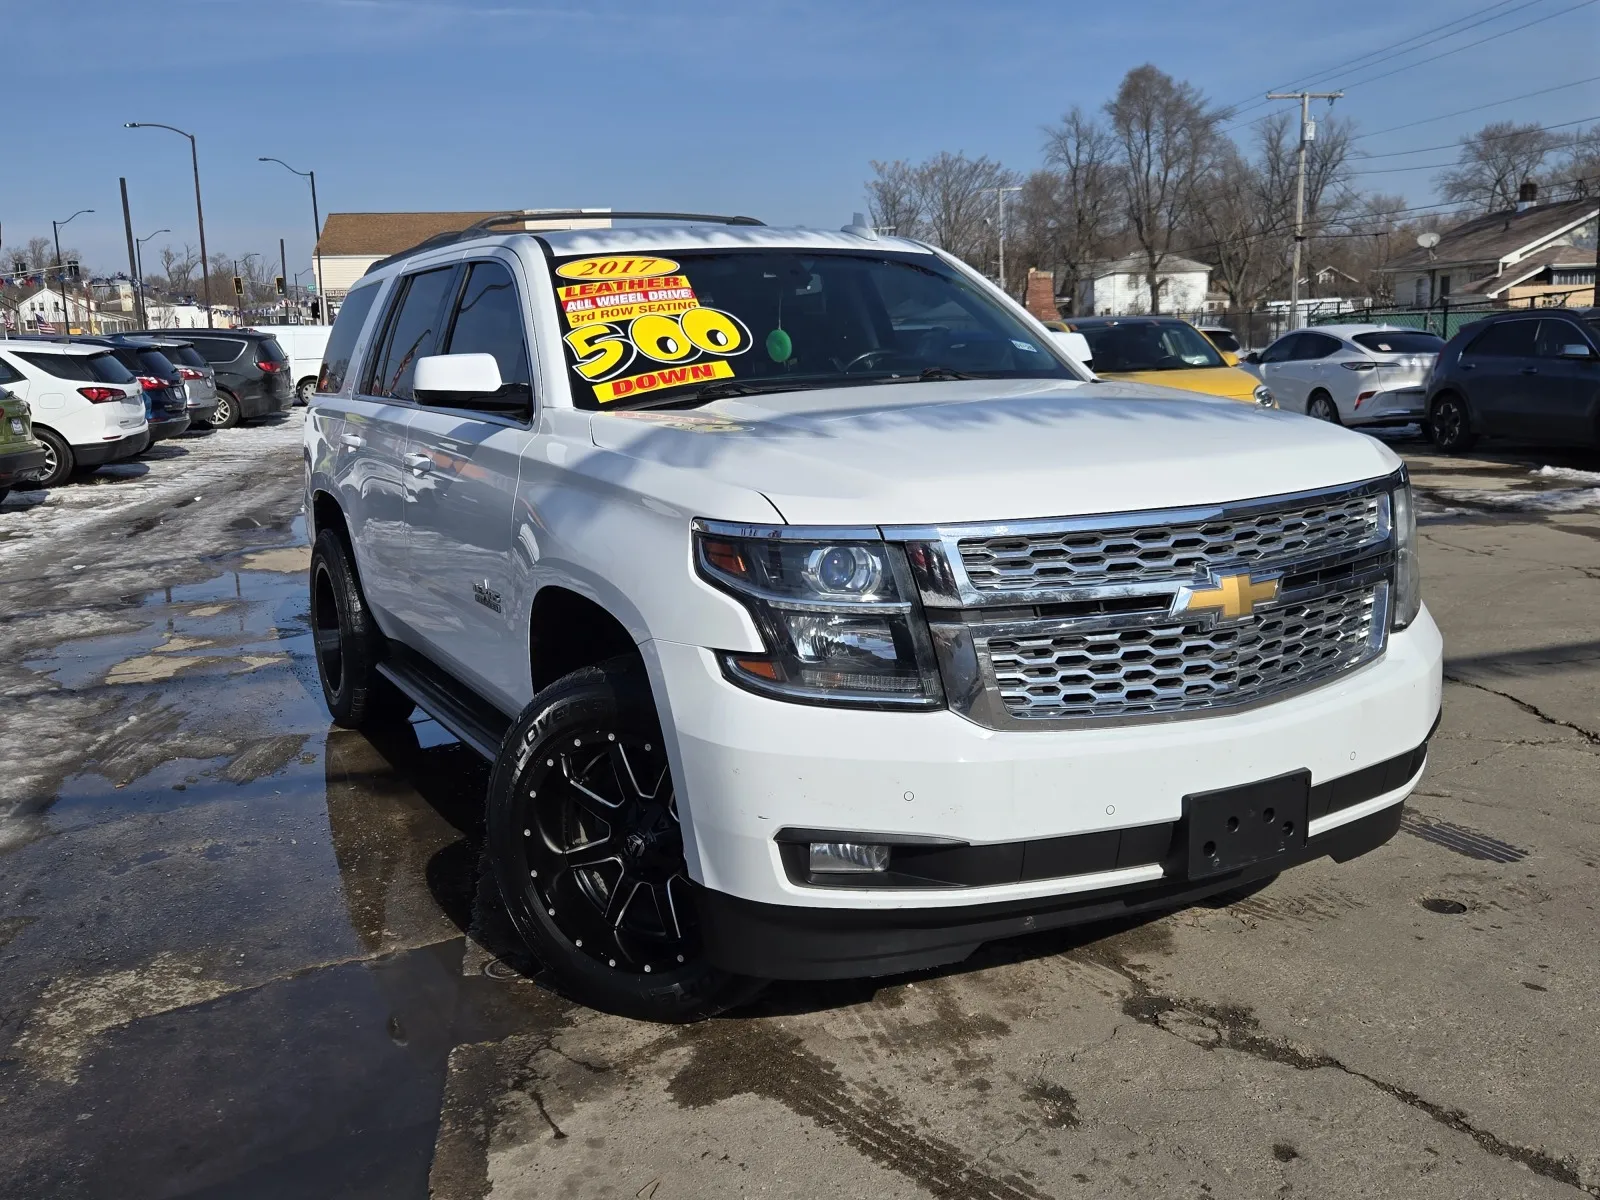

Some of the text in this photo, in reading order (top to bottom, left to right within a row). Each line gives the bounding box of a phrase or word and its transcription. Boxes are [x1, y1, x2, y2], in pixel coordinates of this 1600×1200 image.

[577, 259, 656, 277] 2017
[564, 277, 682, 298] LEATHER
[565, 288, 692, 313] ALL WHEEL DRIVE
[571, 301, 698, 324] 3rd ROW SEATING
[564, 308, 752, 382] 500
[611, 364, 716, 396] DOWN
